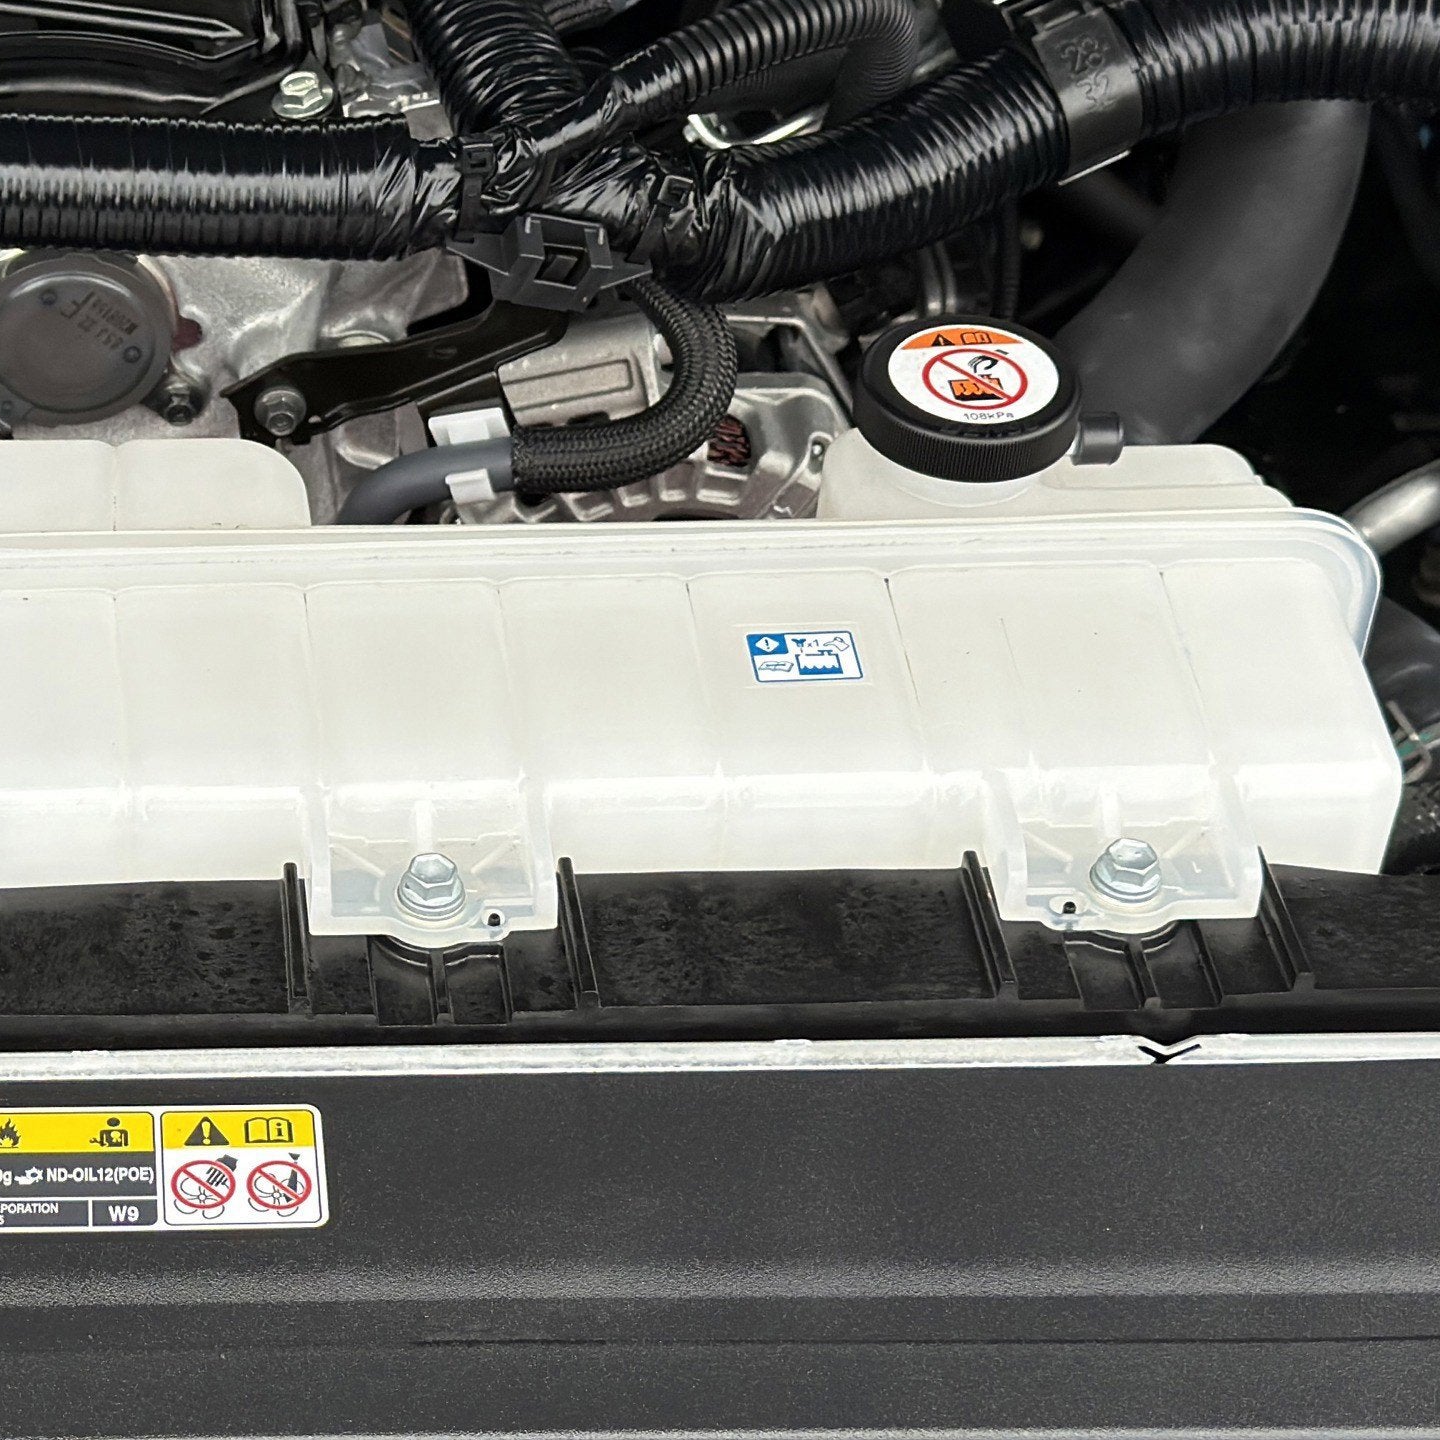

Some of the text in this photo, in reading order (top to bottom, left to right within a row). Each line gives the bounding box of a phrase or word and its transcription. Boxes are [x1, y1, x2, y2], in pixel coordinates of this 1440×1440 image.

[963, 411, 1015, 421] 108kPa
[46, 1166, 155, 1185] ND-OIL12(POE)
[108, 1205, 140, 1223] W9
